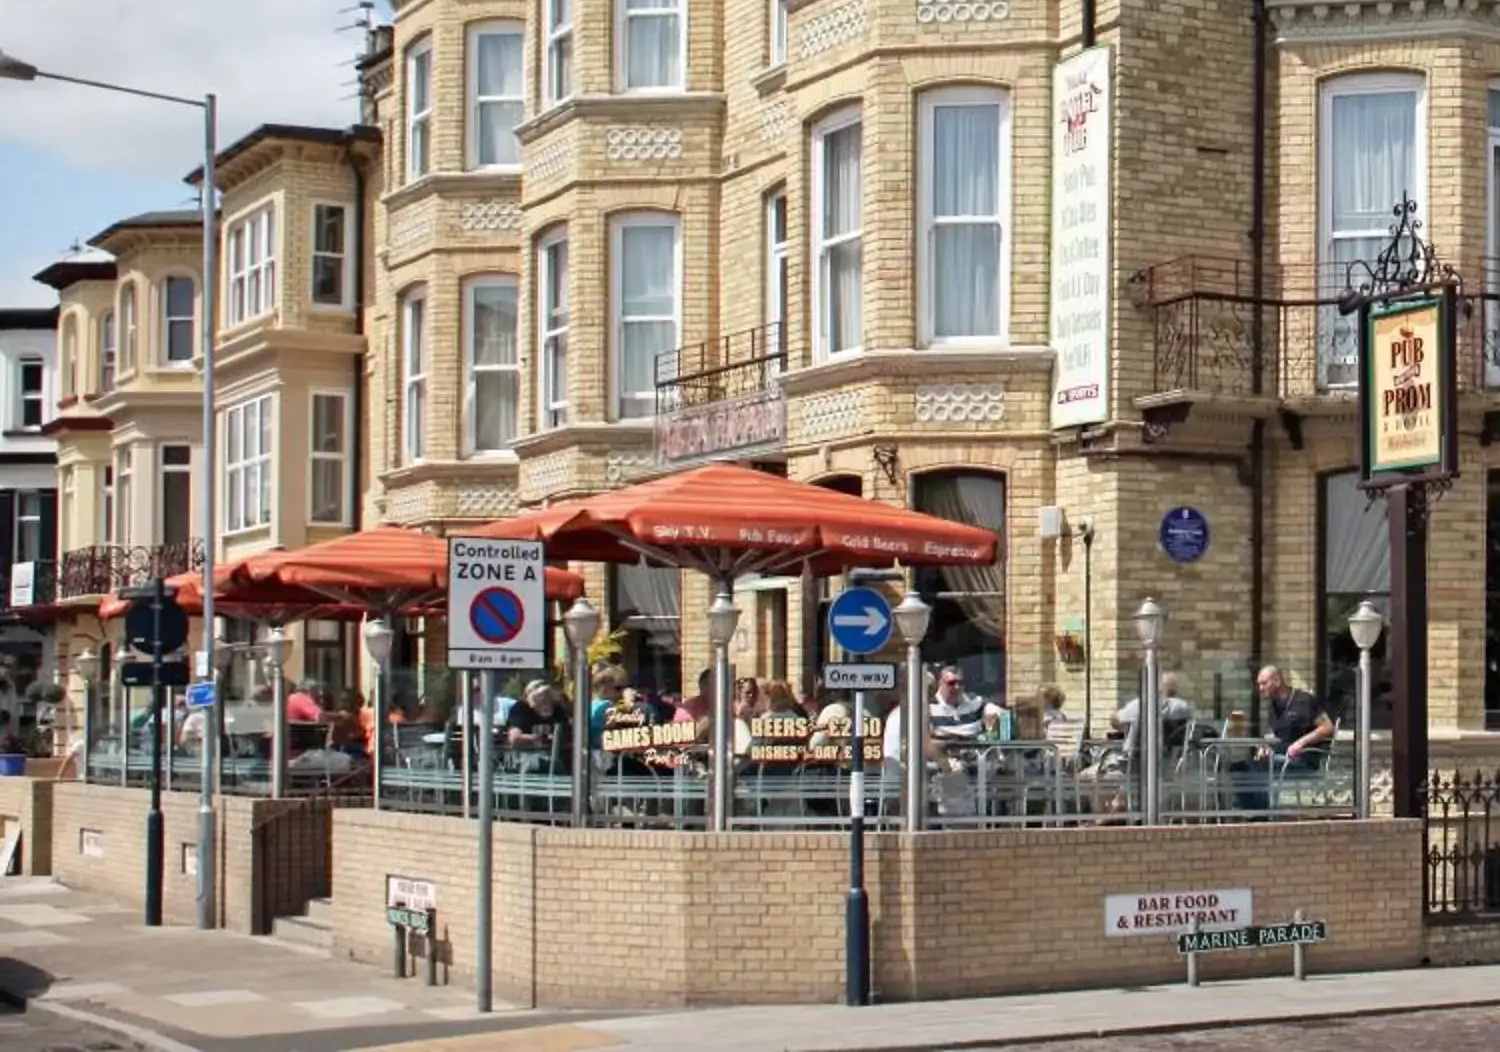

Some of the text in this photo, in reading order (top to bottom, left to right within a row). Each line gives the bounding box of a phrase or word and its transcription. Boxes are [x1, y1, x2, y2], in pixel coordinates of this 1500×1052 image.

[1391, 337, 1424, 368] PUB
[1383, 382, 1432, 417] PROM
[454, 543, 540, 560] Controlled
[457, 563, 538, 581] ZONE A
[830, 669, 889, 685] One way
[602, 720, 695, 751] GAMES ROOM
[751, 717, 807, 737] BEERS
[751, 745, 797, 760] DISHES
[1137, 893, 1219, 911] BAR FOOD
[1117, 914, 1129, 929] &
[1185, 923, 1323, 951] MARINE PARADE
